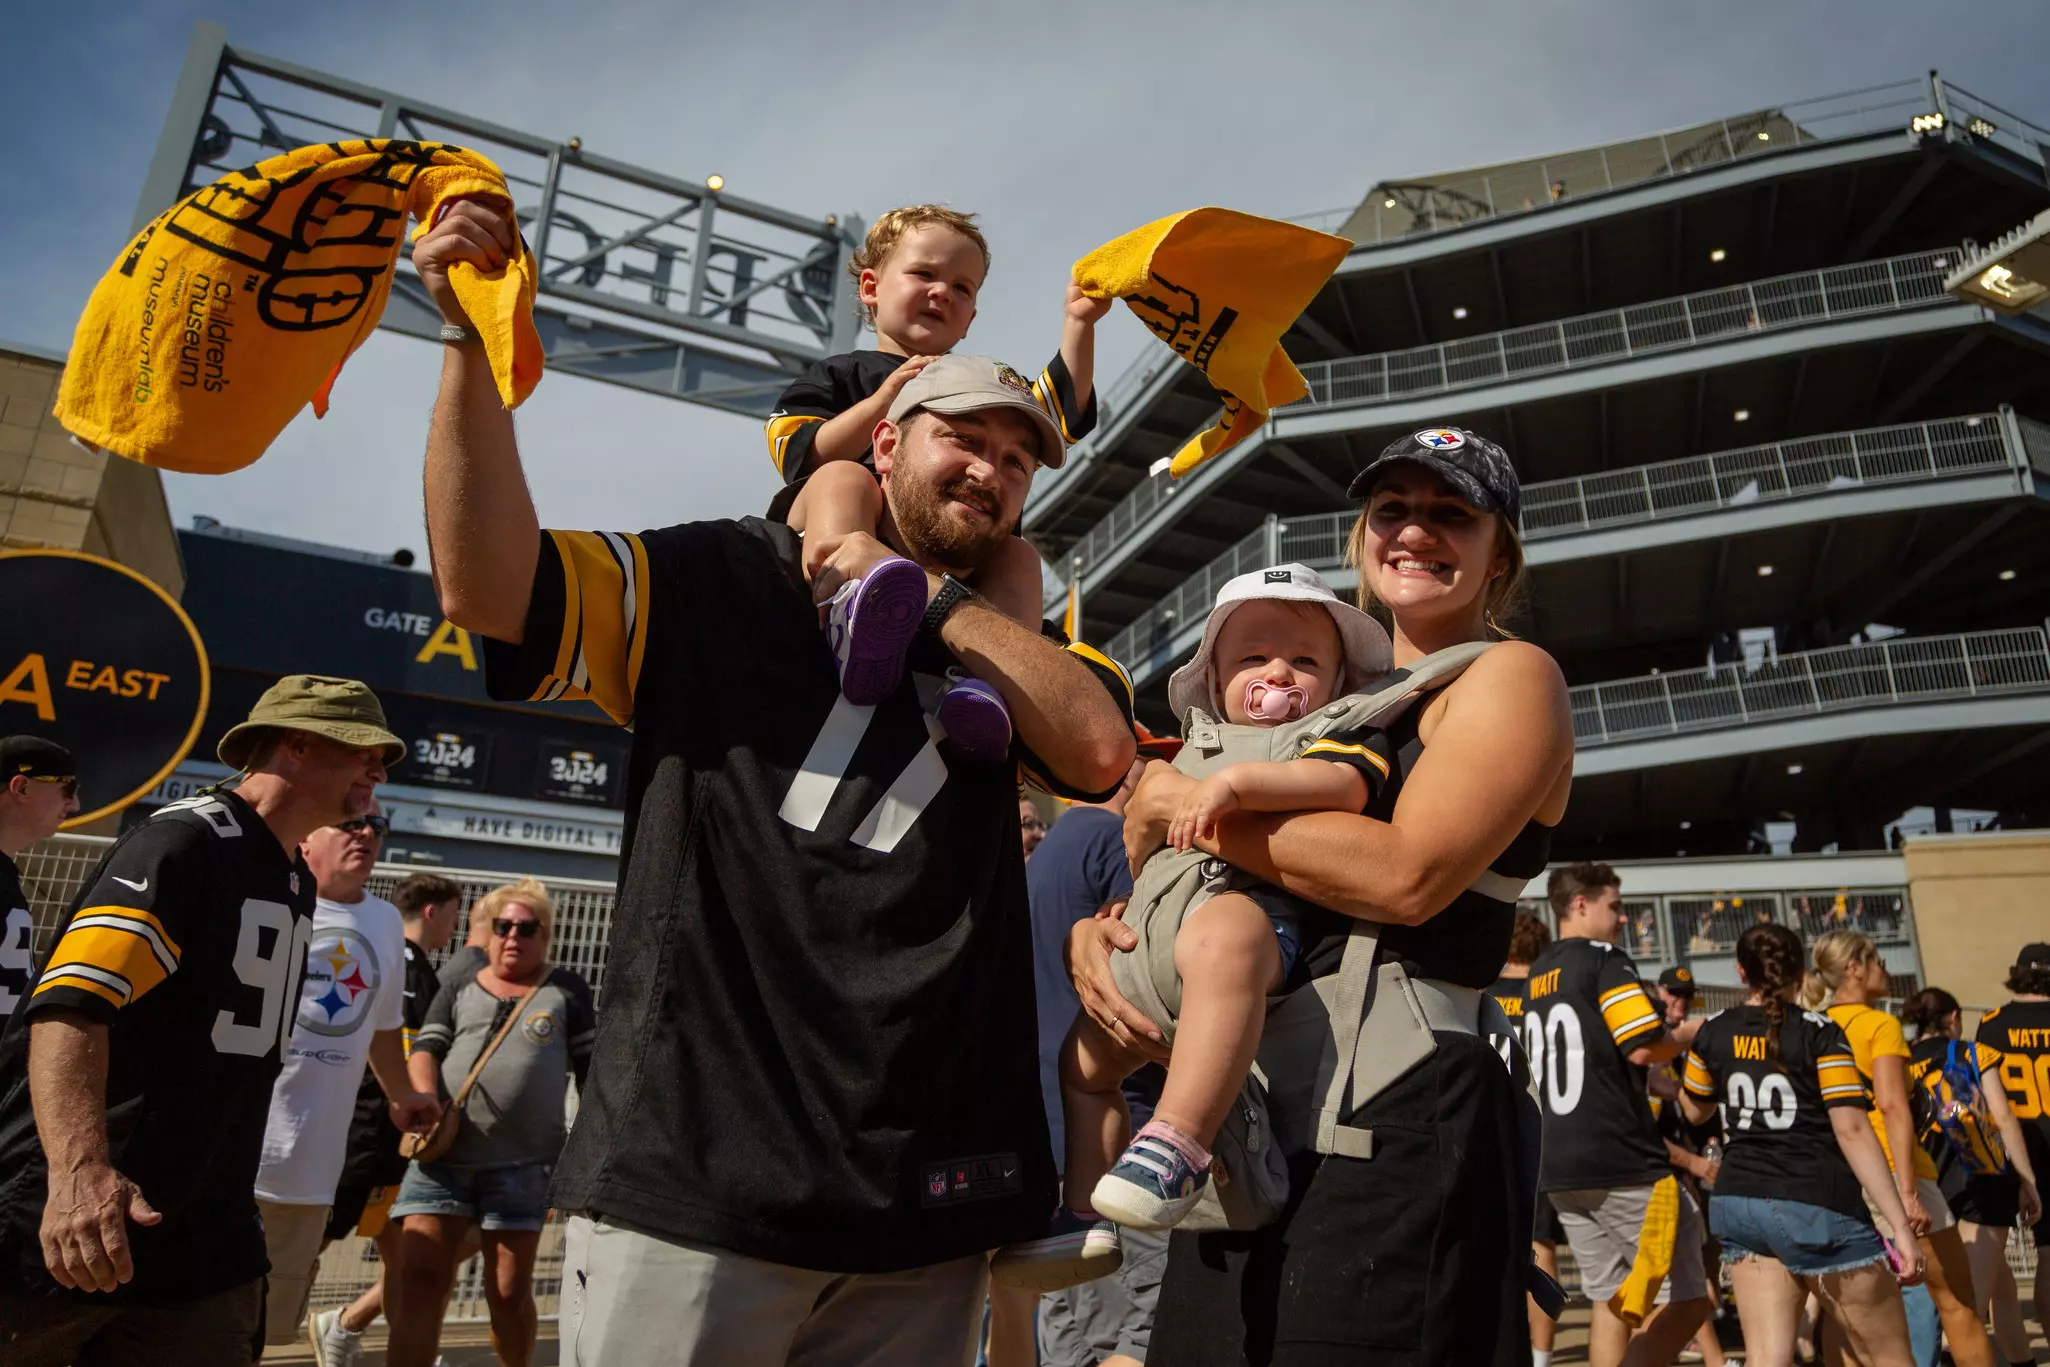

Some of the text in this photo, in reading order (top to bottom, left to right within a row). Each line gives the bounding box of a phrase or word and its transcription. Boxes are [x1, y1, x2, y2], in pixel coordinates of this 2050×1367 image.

[136, 257, 169, 404] museumlab
[181, 272, 211, 388] museum
[203, 282, 234, 393] children's
[363, 607, 479, 672] GATE A
[0, 652, 171, 722] A EAST
[550, 756, 608, 786] 2024
[522, 822, 595, 848] DIGITAL
[1529, 967, 1562, 1001] WATT
[1732, 1035, 1767, 1061] WAT
[2007, 1028, 2050, 1049] WATT
